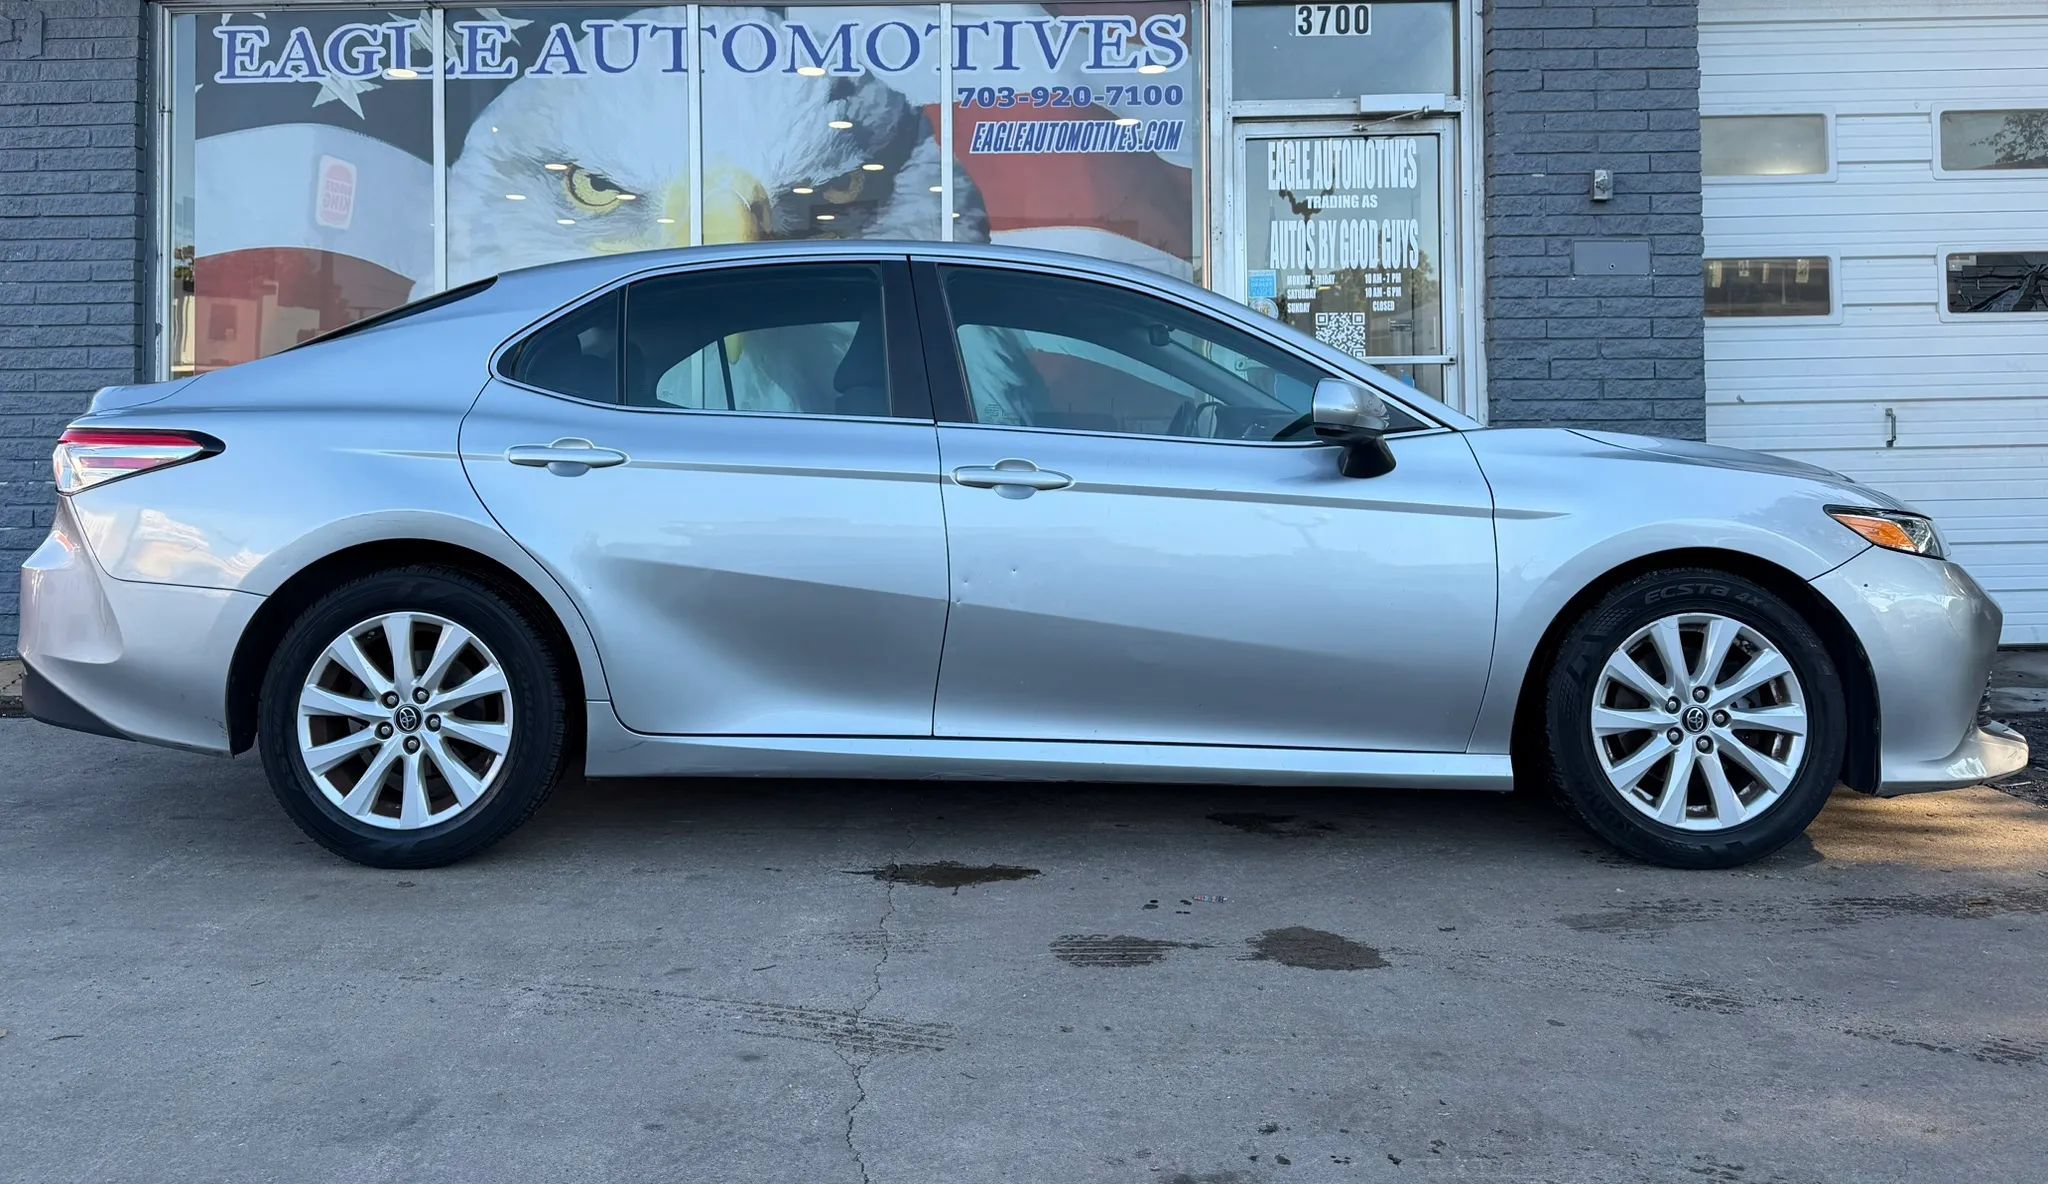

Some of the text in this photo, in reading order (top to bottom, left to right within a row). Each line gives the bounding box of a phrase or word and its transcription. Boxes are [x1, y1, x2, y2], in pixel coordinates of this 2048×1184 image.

[1297, 5, 1370, 35] 3700
[216, 18, 1187, 80] EAGLE AUTOMOTIVES
[957, 85, 1184, 108] 703-920-7100
[971, 119, 1184, 153] EAGLEAUTOMOTIVES.COM
[1268, 138, 1418, 190] EAGLE AUTOMOTIVES
[1306, 194, 1378, 209] TRADING AS
[1270, 219, 1419, 270] AUTOS BY GOOD GUYS
[1287, 274, 1311, 286] MONDAY
[1315, 273, 1336, 285] FRIDAY
[1364, 273, 1372, 284] 10
[1372, 273, 1382, 284] AM
[1386, 273, 1391, 283] 7
[1391, 272, 1402, 284] PM
[1287, 288, 1317, 300] SATURDAY
[1364, 287, 1372, 298] 10
[1372, 287, 1382, 298] AM
[1391, 286, 1402, 297] PM
[1287, 302, 1311, 313] SUNDAY
[1372, 300, 1395, 311] CLOSED
